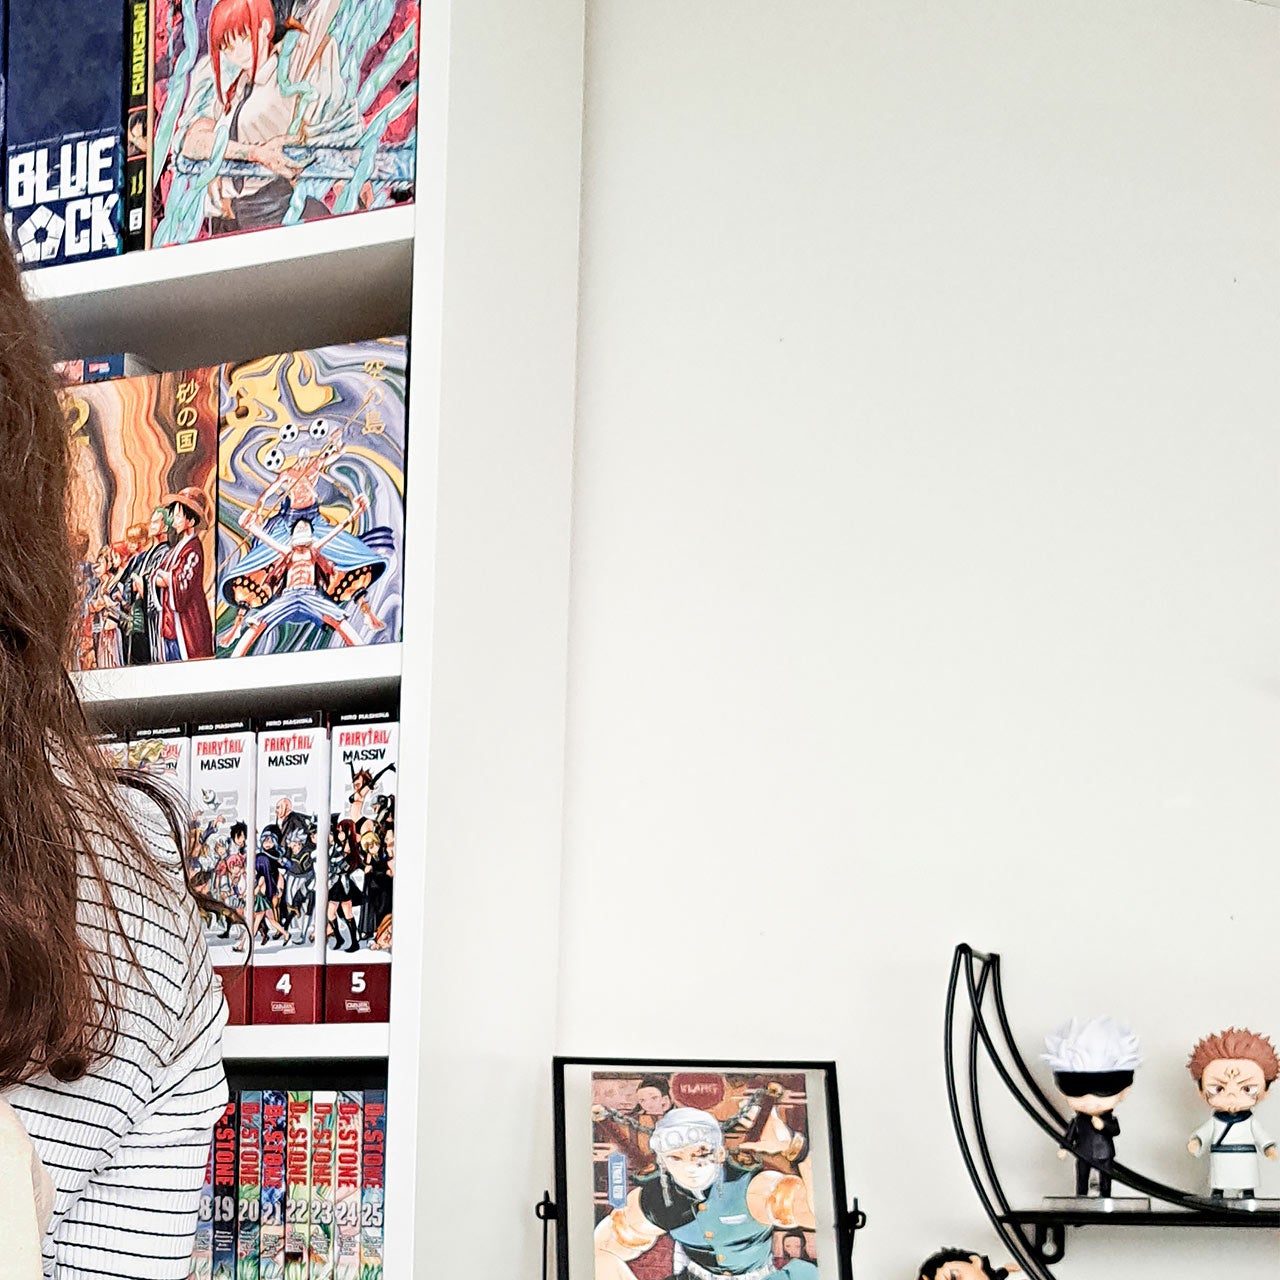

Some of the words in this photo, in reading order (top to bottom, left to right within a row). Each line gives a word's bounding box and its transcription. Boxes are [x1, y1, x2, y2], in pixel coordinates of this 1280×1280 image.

[8, 136, 115, 208] BLUE
[176, 381, 199, 455] 砂の国
[268, 754, 309, 767] MASSIV
[343, 749, 386, 762] MASSIV
[276, 974, 291, 994] 4
[352, 971, 366, 992] 5
[215, 1196, 234, 1221] 19
[239, 1200, 259, 1221] 20
[287, 1200, 307, 1224] 22
